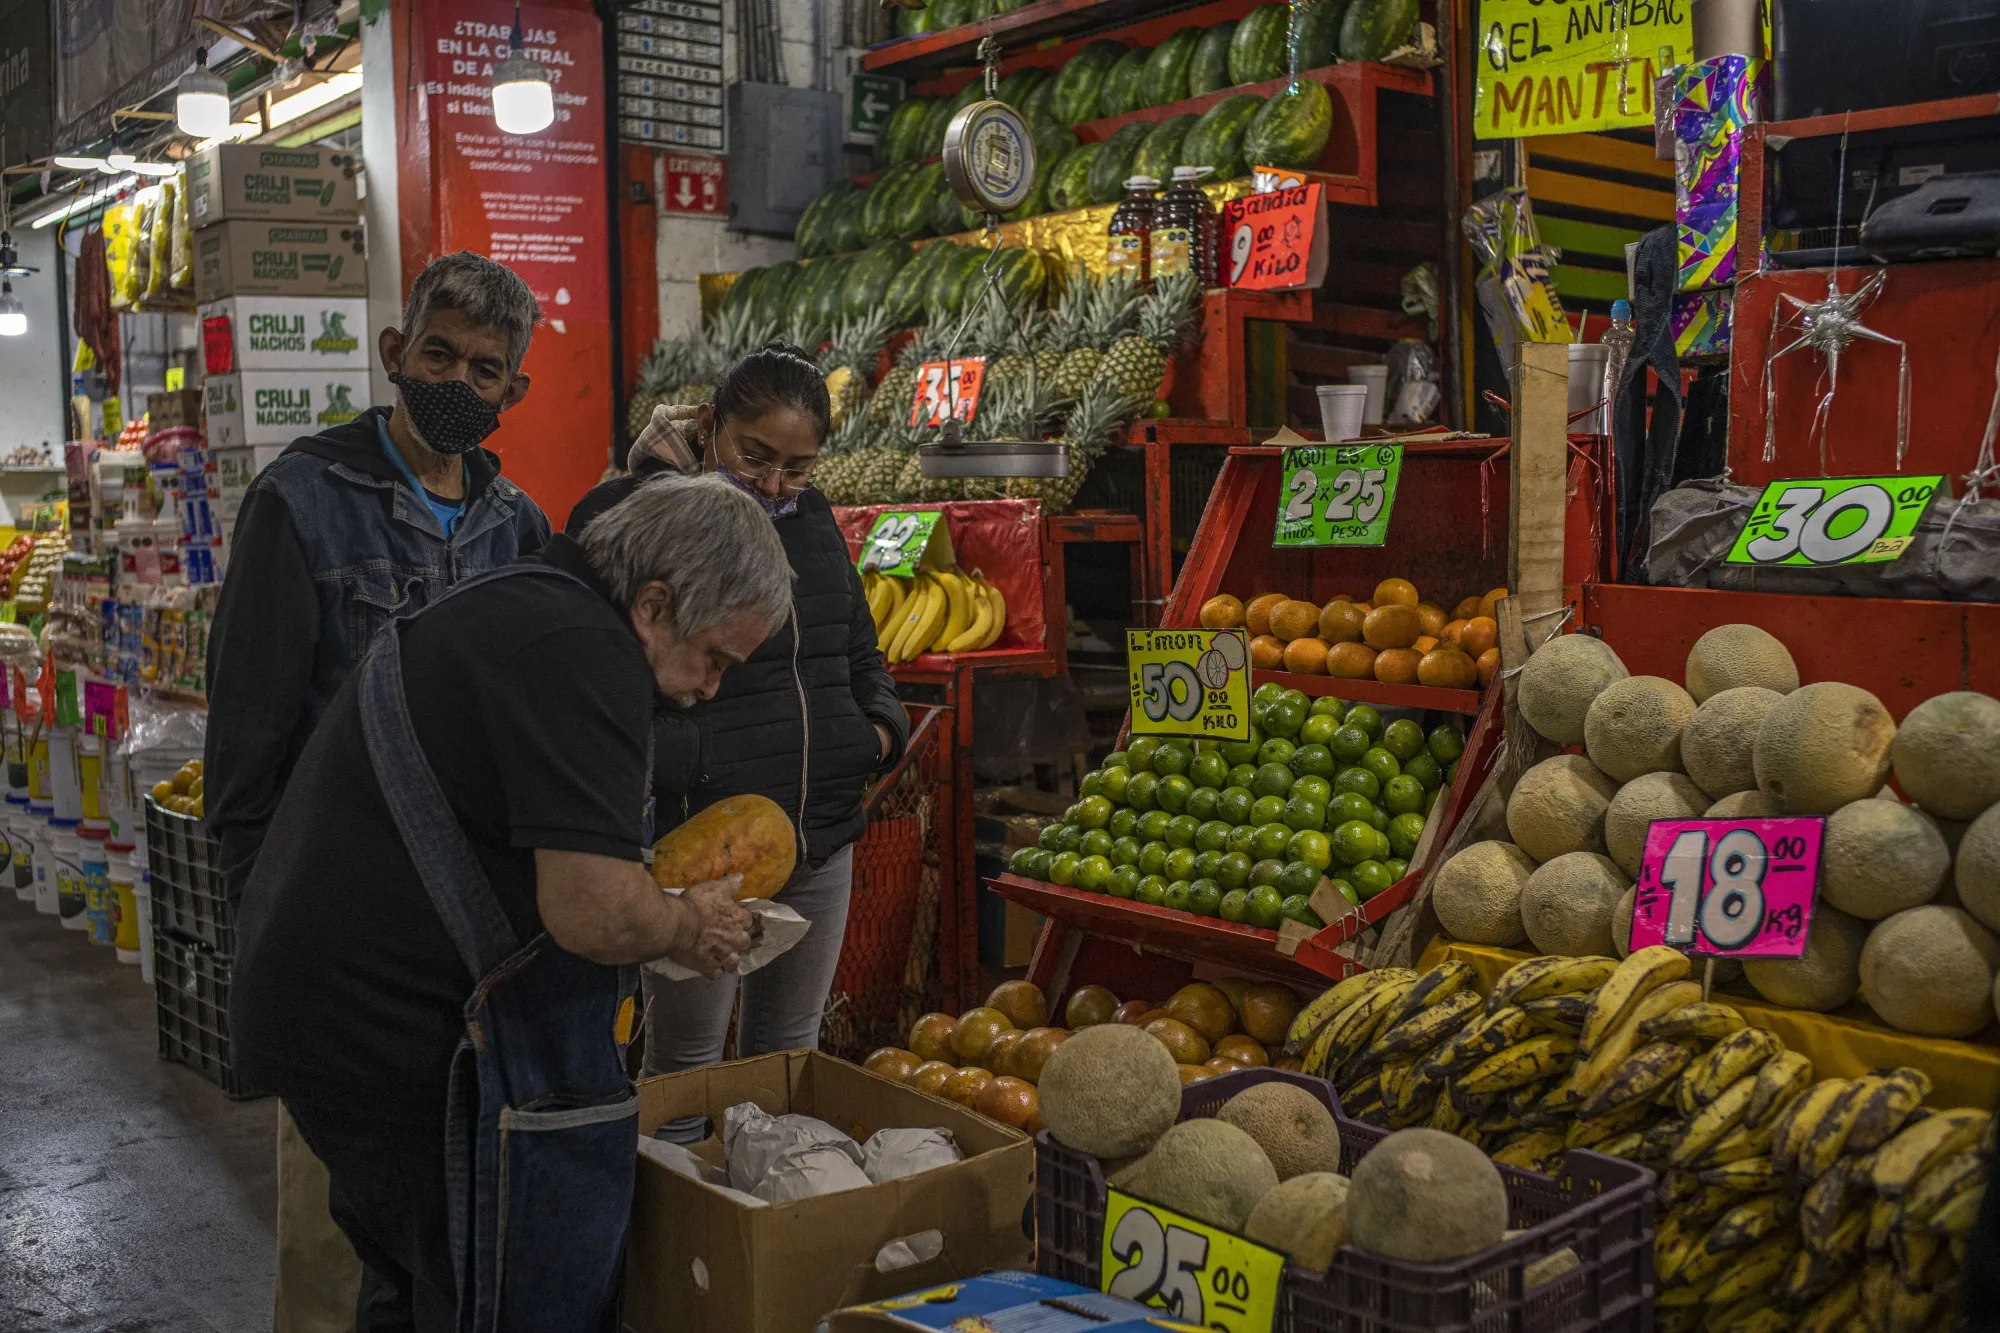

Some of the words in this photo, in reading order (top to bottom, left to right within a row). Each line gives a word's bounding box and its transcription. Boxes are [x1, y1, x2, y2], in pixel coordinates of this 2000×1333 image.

[454, 20, 557, 45] ¿TRABJAS
[437, 39, 462, 56] EN
[466, 40, 490, 58] LA
[1487, 17, 1552, 73] GEL
[452, 60, 478, 76] DE
[244, 174, 290, 191] CRUJI
[244, 190, 291, 204] NACHOS
[1230, 187, 1309, 223] Sandia
[252, 251, 298, 268] CRUJI
[1230, 223, 1252, 285] 9
[252, 267, 299, 280] NACHOS
[249, 314, 305, 334] CRUJI
[249, 336, 305, 352] NACHOS
[255, 388, 311, 410] CRUJI
[256, 410, 312, 426] NACHOS
[1285, 468, 1319, 523] 2
[1324, 468, 1388, 524] 25
[1330, 525, 1369, 540] PESOS
[1746, 483, 1895, 565] 30
[1141, 660, 1205, 722] 50
[1208, 691, 1229, 704] 00
[1660, 828, 1769, 950] 18
[1773, 836, 1807, 860] 00
[1108, 1206, 1210, 1326] 25
[1212, 1265, 1250, 1302] 00
